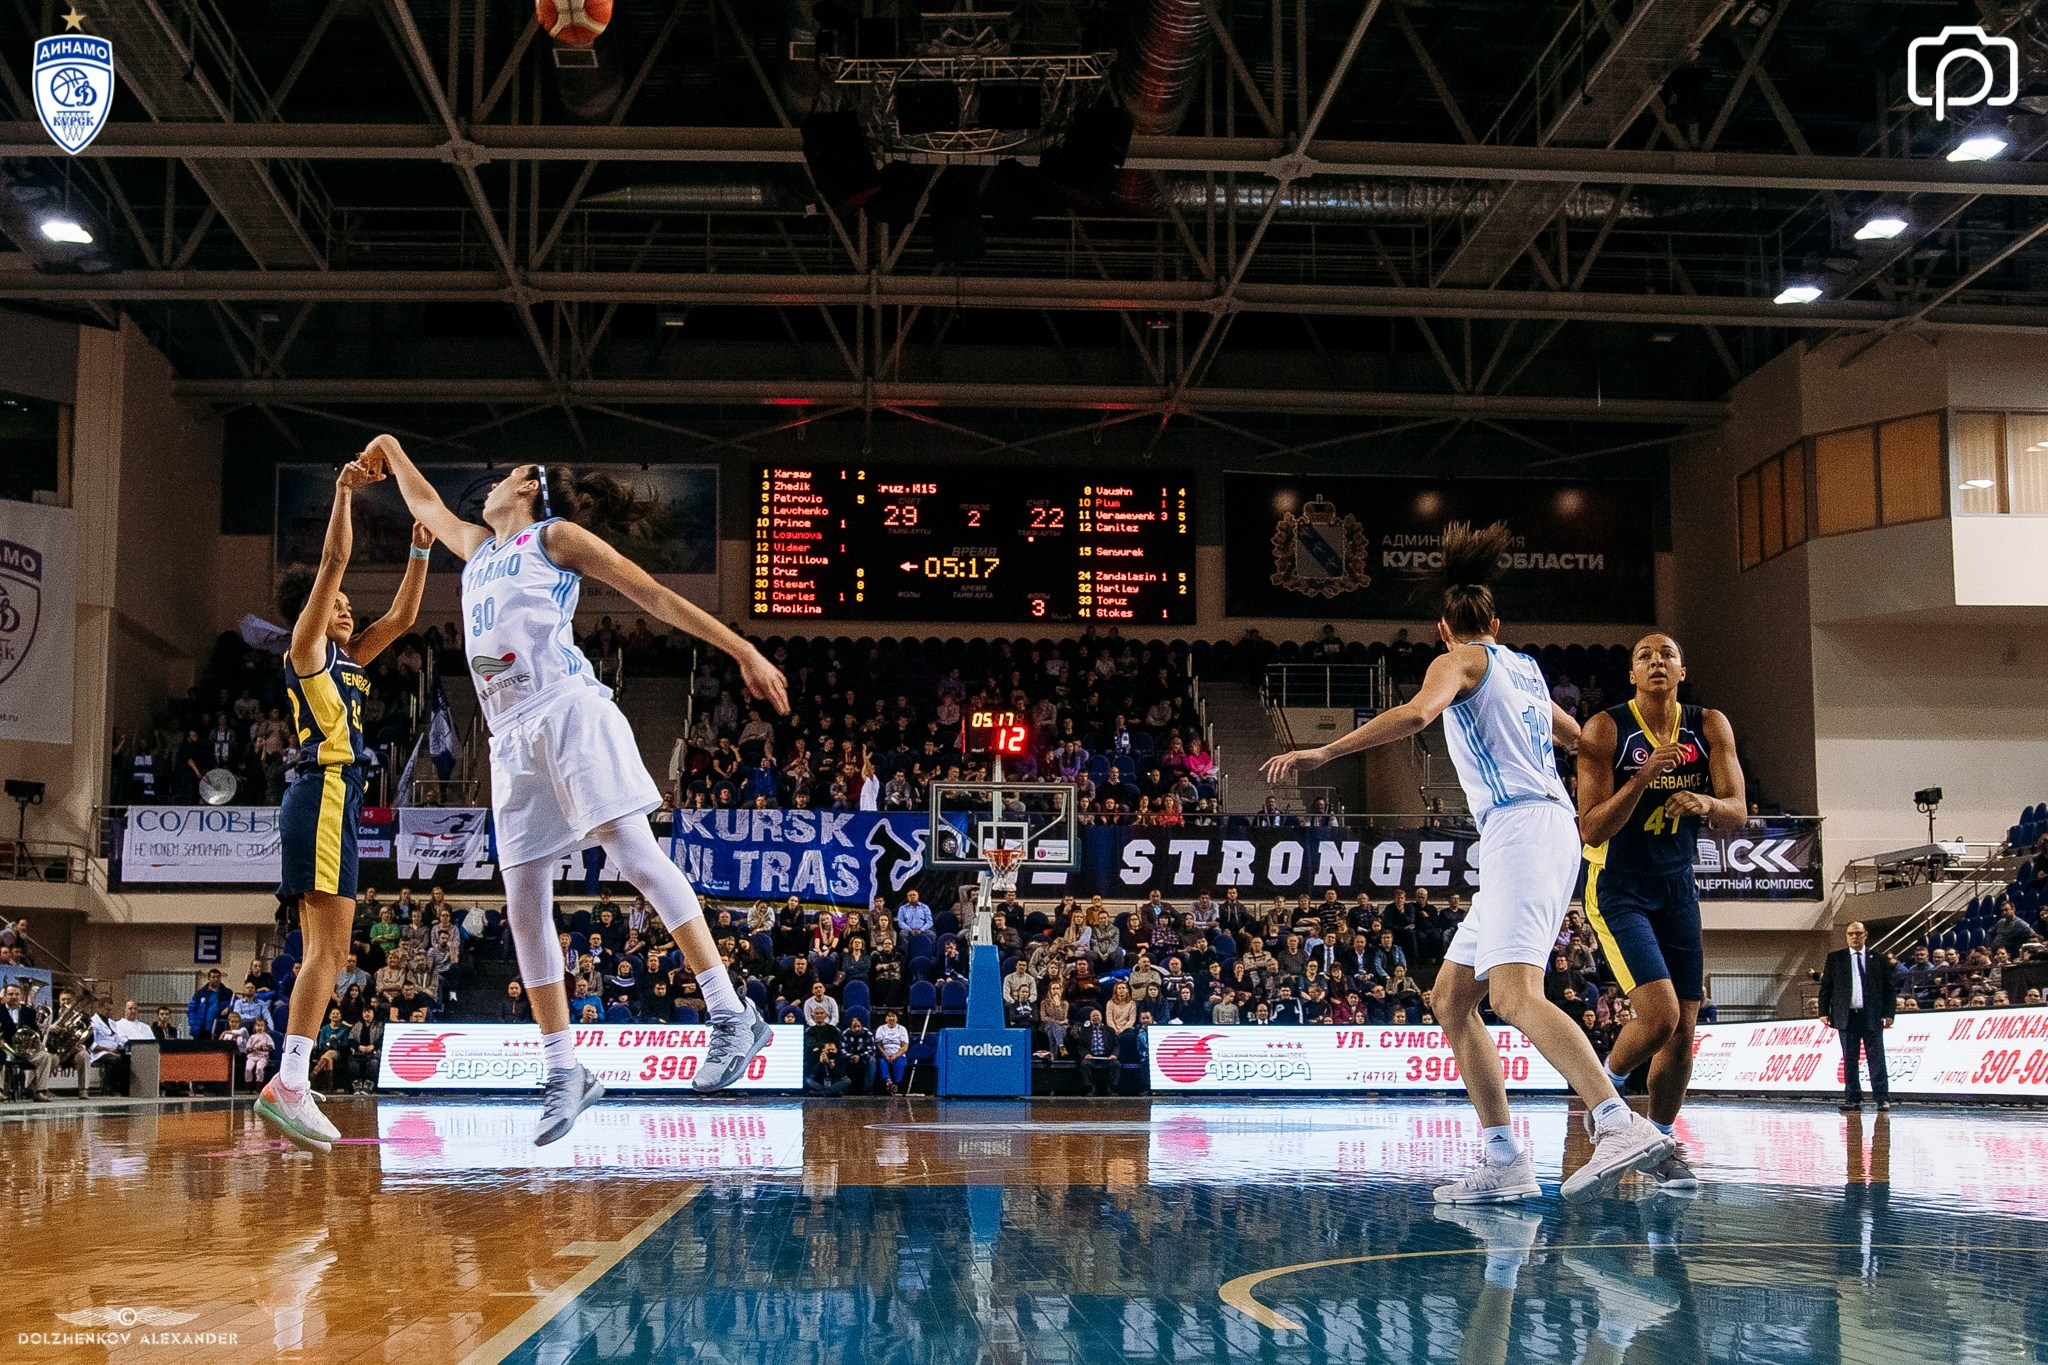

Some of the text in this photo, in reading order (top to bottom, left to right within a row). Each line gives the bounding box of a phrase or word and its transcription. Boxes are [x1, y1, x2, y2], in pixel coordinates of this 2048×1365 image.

[763, 469, 769, 478] 1
[841, 470, 846, 479] 1
[858, 470, 865, 480] 2
[762, 481, 811, 490] 3 Zhedik
[1084, 486, 1092, 495] 8
[1162, 488, 1167, 497] 1
[1178, 488, 1186, 497] 4
[761, 493, 769, 502] 5
[857, 494, 865, 504] 5
[1079, 498, 1185, 509] 10 Plum 1 2
[761, 505, 829, 515] 9 Levchenko
[884, 505, 918, 526] 29
[1079, 510, 1090, 519] 11
[1161, 512, 1168, 521] 3
[1178, 512, 1186, 521] 5
[756, 518, 846, 528] 10 Prince 1
[968, 510, 980, 527] 2
[1031, 507, 1064, 528] 22
[1079, 523, 1187, 533] 12 Canitez 2
[756, 530, 768, 539] 11
[756, 542, 846, 553] 12 Vidmer 1
[952, 547, 997, 557] ВРЕМЯ
[1079, 547, 1144, 557] 15 Senyurek
[756, 554, 829, 565] 13 Kirillova
[1382, 551, 1604, 570] КУРС ОБЛАСТИ
[755, 566, 865, 578] 15 Cruz 8
[924, 557, 1000, 578] 05:17
[1078, 571, 1186, 582] 24 Zandalasin 1 5
[755, 579, 865, 590] 30 Stewart 8
[1078, 584, 1187, 594] 32 Hartley 2
[754, 591, 864, 602] 31 Charles 1 6
[1078, 596, 1127, 606] 33 Topuz
[754, 603, 768, 613] 33
[1032, 600, 1045, 616] 3
[1078, 609, 1091, 617] 41
[1096, 609, 1133, 618] Stokes
[1162, 609, 1168, 618] 1
[472, 596, 495, 637] 30
[999, 727, 1025, 752] 12
[1645, 773, 1702, 790] NERBAHÇE
[681, 808, 856, 848] KURSK
[135, 843, 146, 856] НЕ
[414, 849, 465, 858] ГЕПАРД
[674, 838, 861, 897] ULTRAS
[1755, 878, 1814, 890] КОМПЛЕКС
[198, 934, 218, 960] E
[1948, 1017, 1975, 1041] УЛ.
[575, 1030, 608, 1047] УЛ.
[1336, 1031, 1371, 1048] УЛ.
[1748, 1028, 1766, 1047] УЛ.
[958, 1043, 1012, 1056] molten
[436, 1058, 544, 1079] АВРОРА
[1205, 1060, 1311, 1080] АВРОРА
[1759, 1053, 1822, 1082] 390-900
[1971, 1049, 2048, 1085] 390-90
[1346, 1072, 1358, 1080] +7
[1363, 1071, 1397, 1083] (4712)
